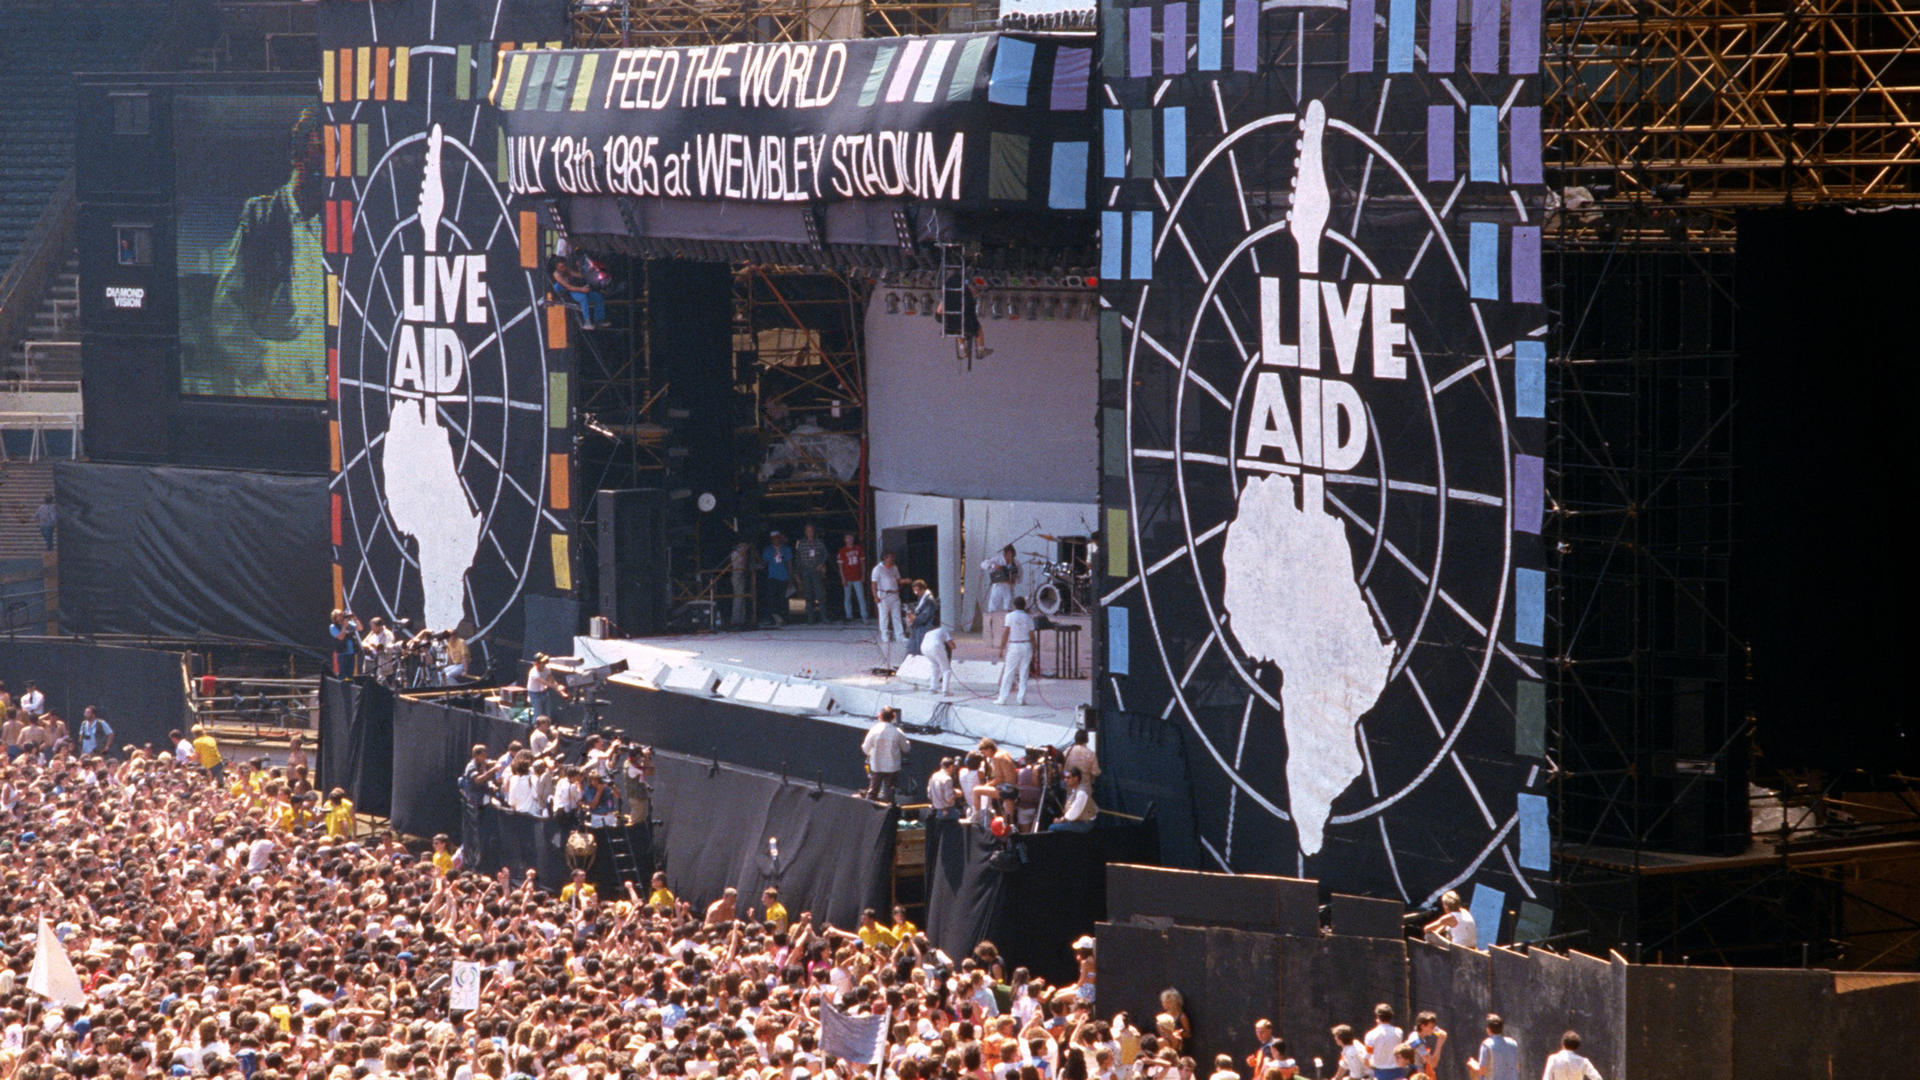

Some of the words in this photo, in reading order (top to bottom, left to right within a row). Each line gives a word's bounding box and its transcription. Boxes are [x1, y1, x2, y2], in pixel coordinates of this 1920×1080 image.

[604, 49, 680, 110] FEED
[681, 43, 739, 108] THE
[739, 42, 847, 108] WORLD
[507, 135, 547, 195] JULY
[550, 135, 602, 194] 13th
[603, 134, 660, 197] 1985
[664, 141, 692, 197] at
[696, 133, 827, 201] WEMBLEY
[106, 287, 144, 298] DIAMOND
[114, 297, 142, 308] VISION
[403, 254, 488, 324] LIVE
[393, 324, 463, 394] AID
[1260, 276, 1408, 380] LIVE
[1245, 372, 1368, 471] AID
